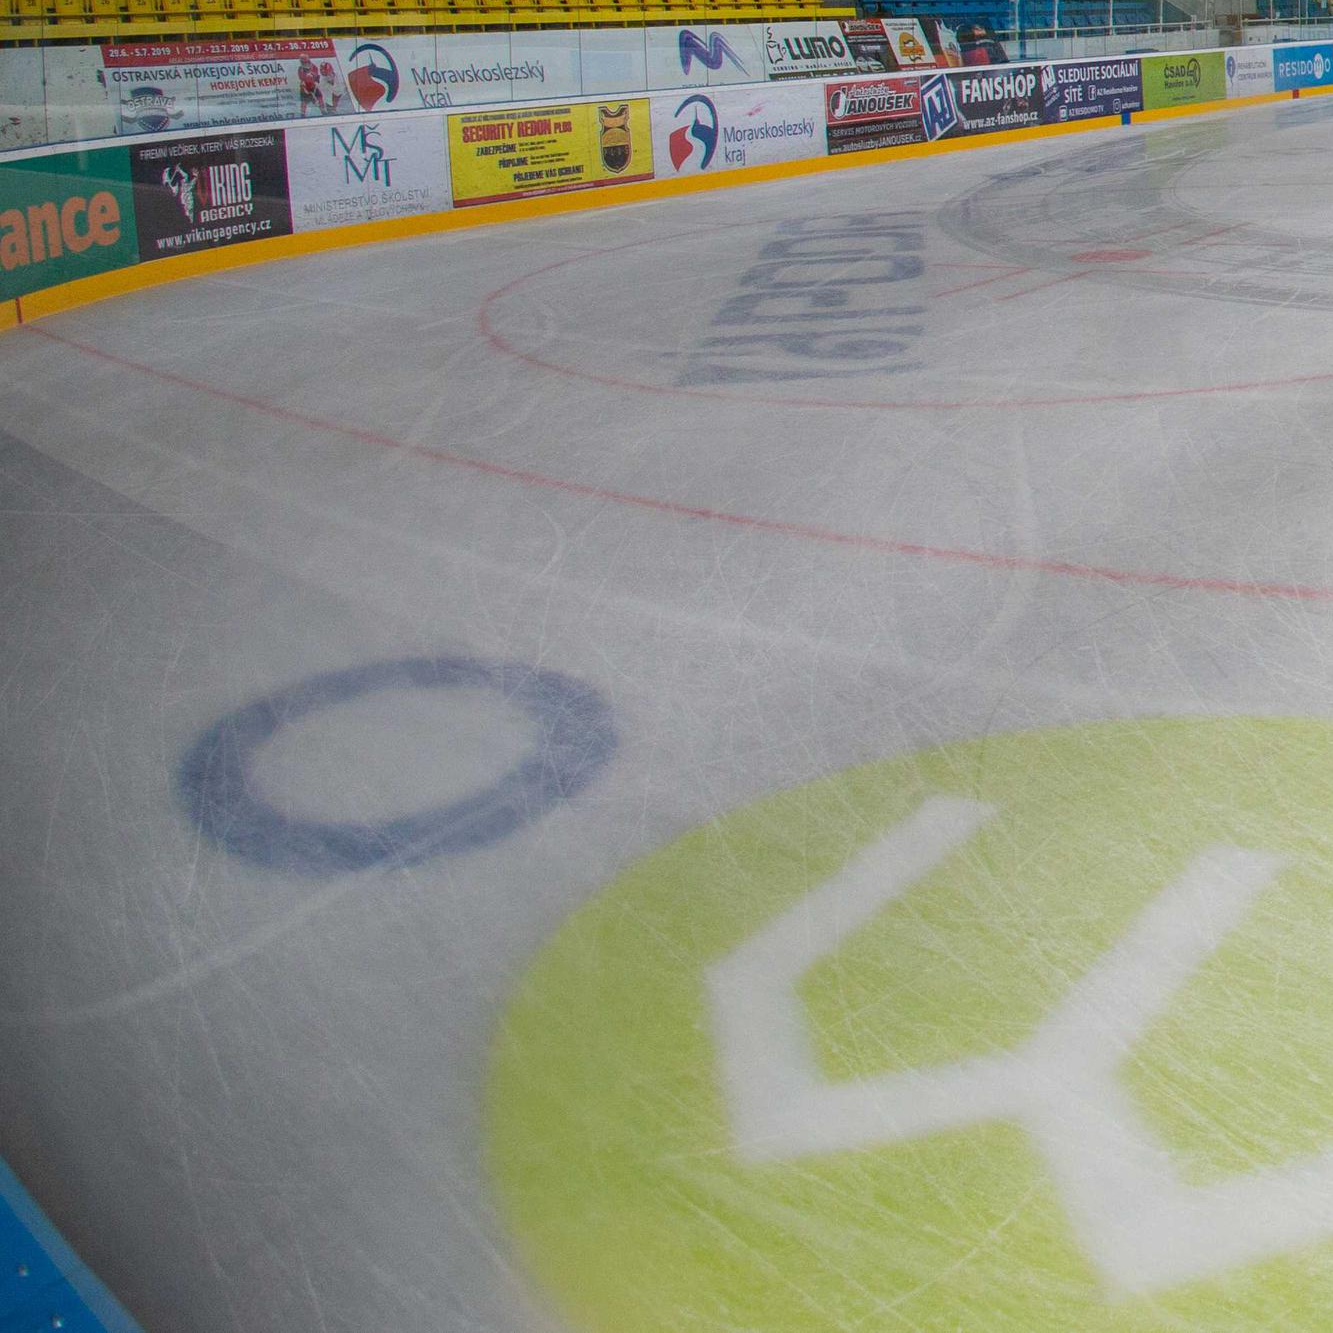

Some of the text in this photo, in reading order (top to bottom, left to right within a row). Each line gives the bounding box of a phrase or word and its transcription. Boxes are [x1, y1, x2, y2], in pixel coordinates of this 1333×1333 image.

[151, 47, 171, 56] 2019
[231, 44, 249, 53] 2019
[311, 40, 329, 49] 2019
[784, 34, 846, 61] LUMO
[112, 67, 182, 83] OSTRAVSKÁ
[184, 63, 244, 80] HOKEJOVÁ
[247, 59, 285, 75] ŠKOLA
[411, 60, 545, 83] Moravskoslezský
[1057, 58, 1139, 84] SLEDUJTE SOCIÁLNÍ
[1164, 62, 1186, 78] ČSAD
[1279, 53, 1331, 79] RESIDOMO
[210, 75, 288, 91] HOKEJOVÉ KEMPY
[961, 74, 1036, 104] FANSHOP
[1064, 83, 1084, 104] SÍTĚ
[128, 96, 173, 111] OSTRAVA
[418, 87, 453, 107] kraj
[723, 117, 815, 144] Moravskoslezský
[963, 111, 1039, 130] www.az-fanshop.cz
[462, 122, 514, 143] SECURITY
[201, 138, 223, 153] KTERÝ
[224, 138, 238, 149] VÁS
[239, 135, 275, 149] ROZSEKÁ!
[724, 146, 746, 165] kraj
[196, 161, 252, 208] VIKING
[303, 186, 431, 213] MINISTERSTVO ŠKOLSTVÍ
[200, 204, 254, 223] AGENCY
[156, 219, 272, 250] www.vikingagency.cz
